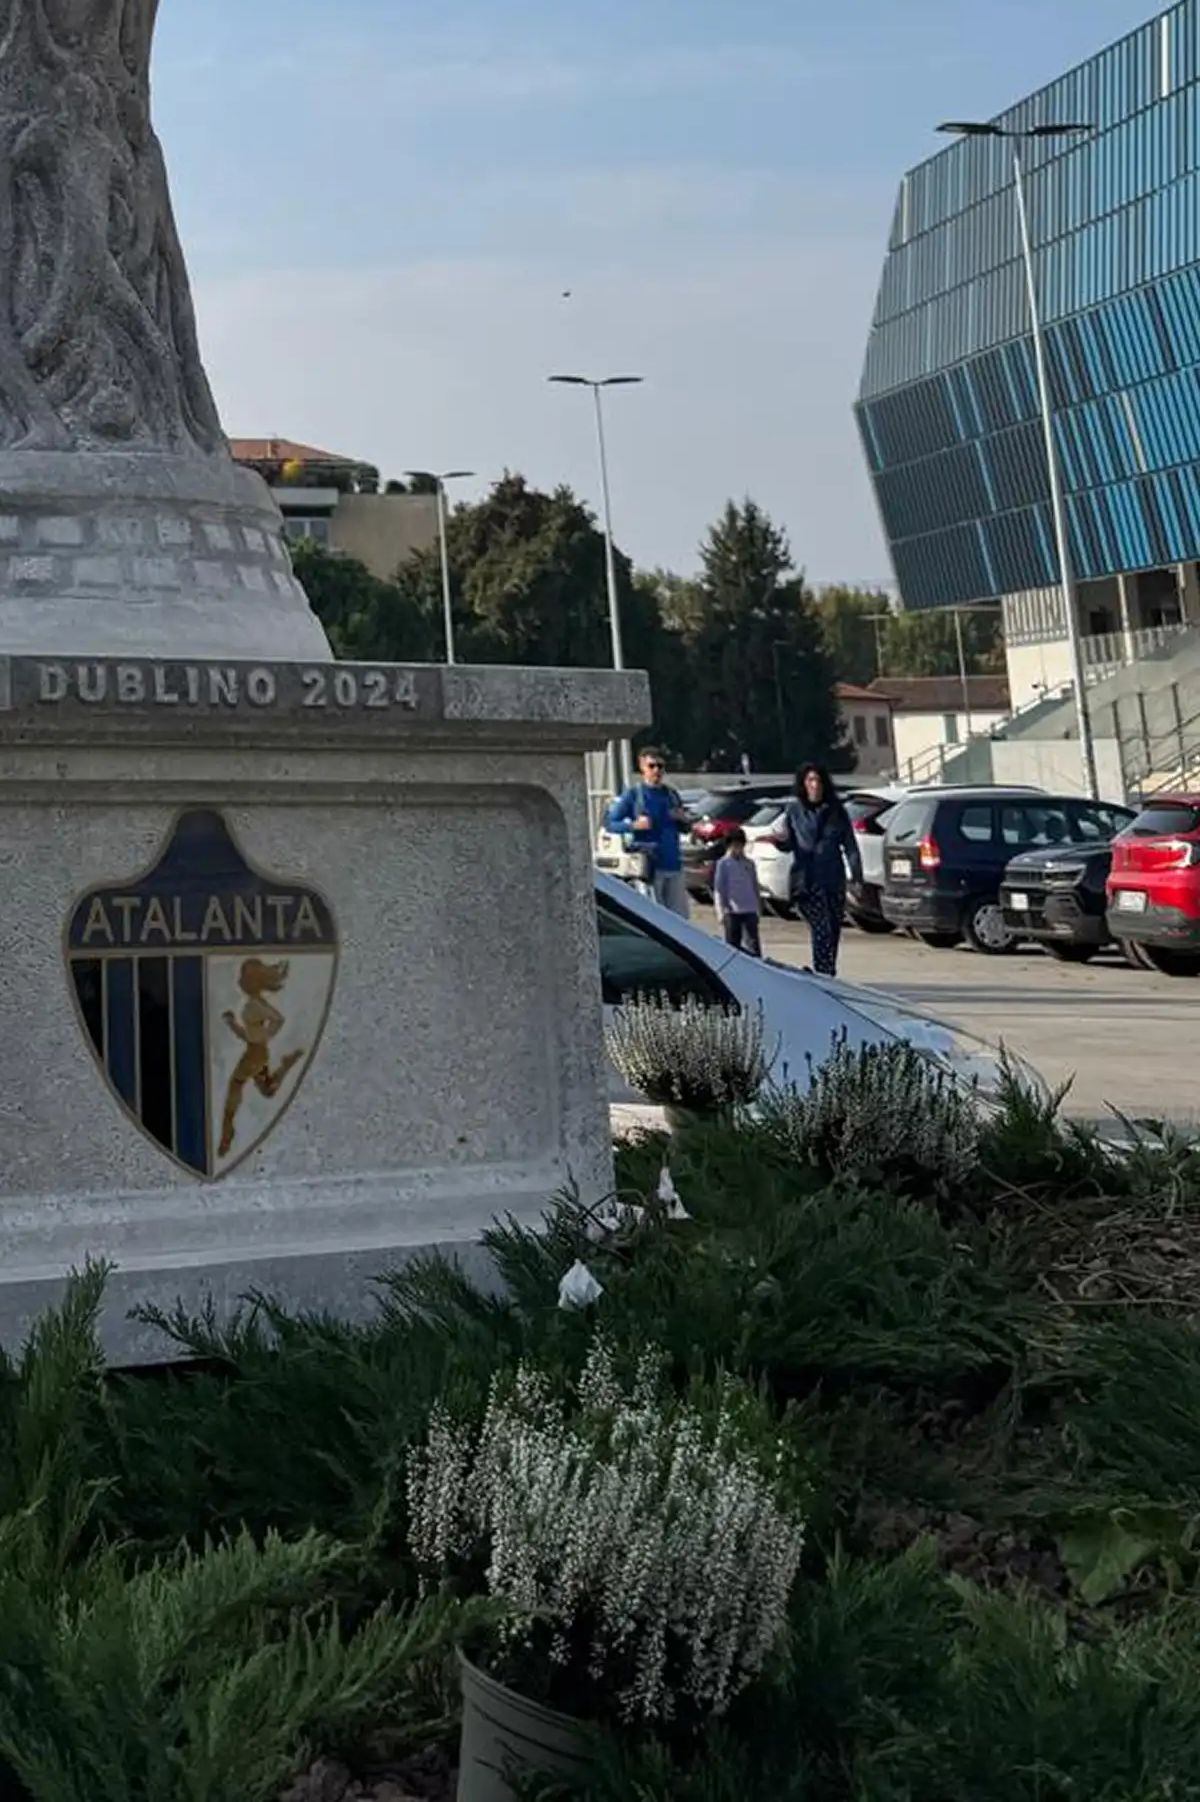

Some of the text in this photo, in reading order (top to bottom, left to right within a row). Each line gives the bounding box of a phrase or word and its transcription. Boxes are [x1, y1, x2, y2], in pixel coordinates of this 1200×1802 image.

[38, 662, 420, 710] DUBLINO 2024
[81, 895, 324, 943] ATALANTA
